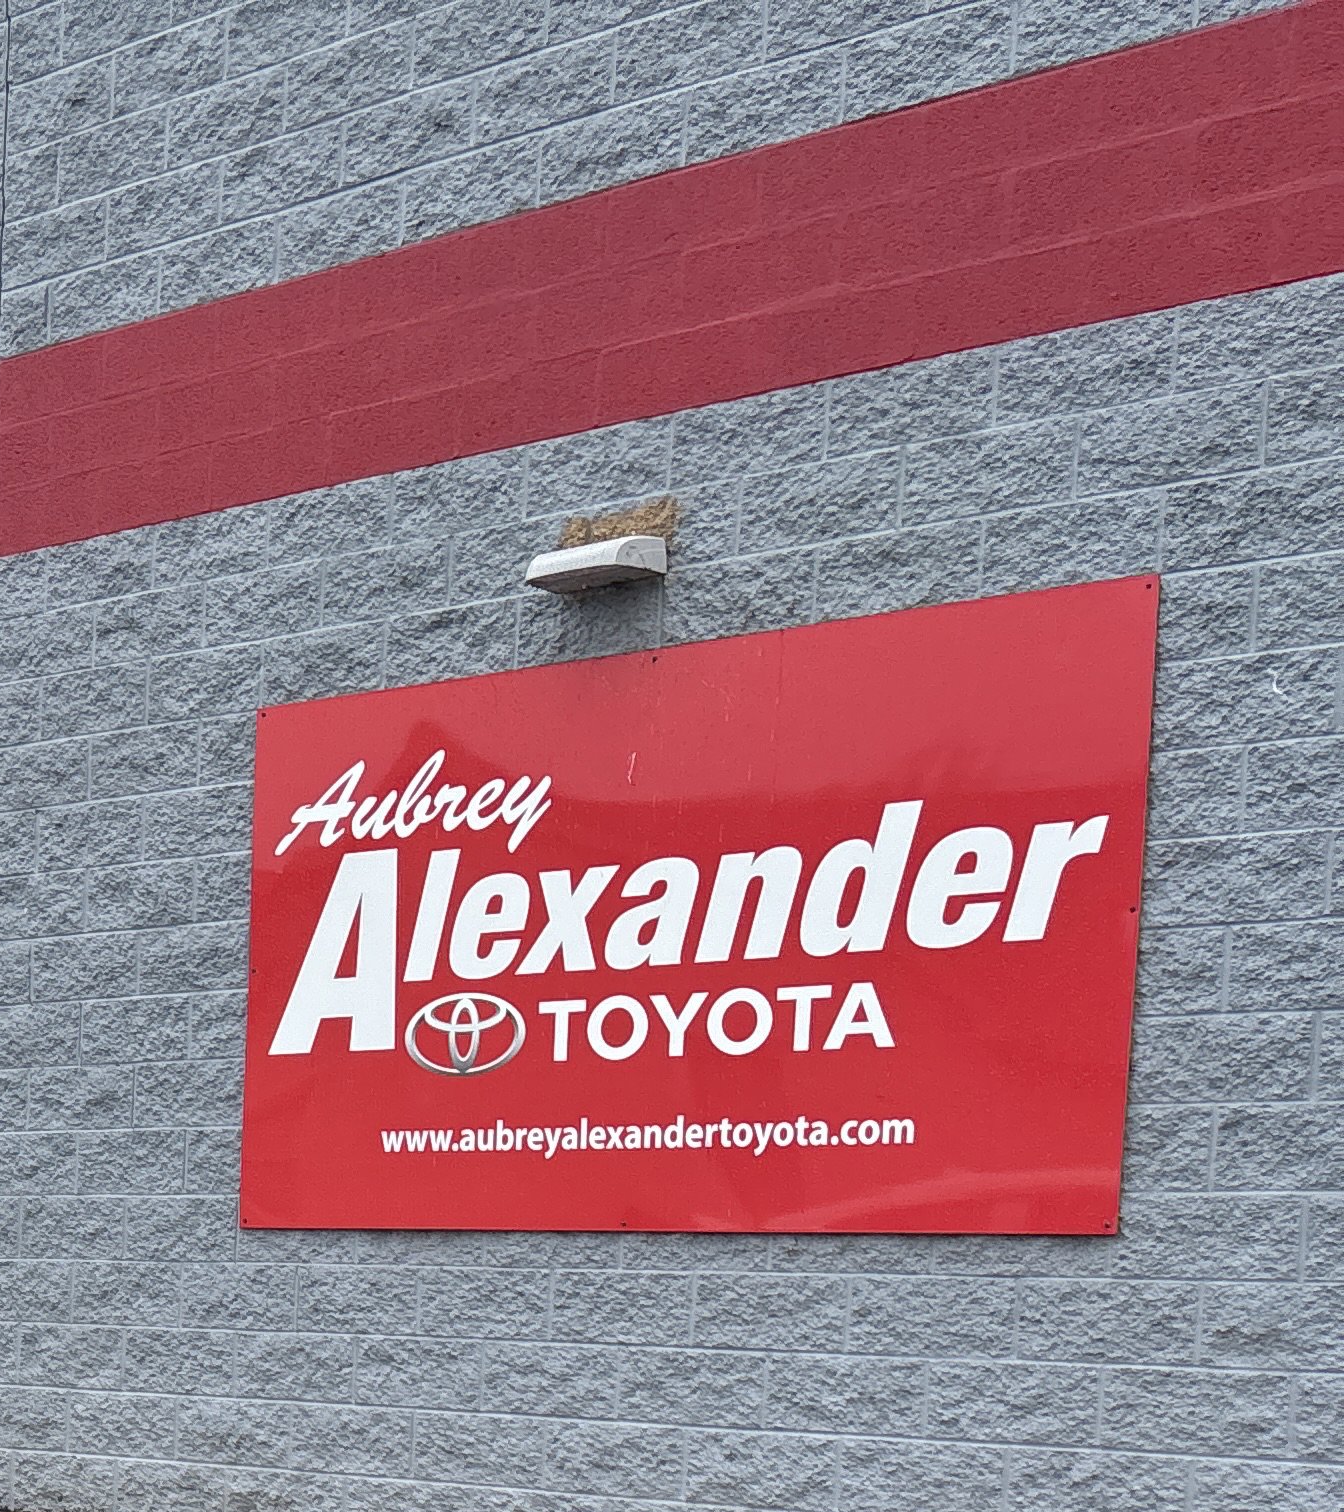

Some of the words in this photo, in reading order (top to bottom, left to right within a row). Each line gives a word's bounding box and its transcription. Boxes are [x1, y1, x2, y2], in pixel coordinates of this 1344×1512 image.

[274, 749, 552, 856] Aubrey
[267, 799, 1110, 1056] Alexander
[538, 982, 896, 1062] TOYOTA
[380, 1113, 915, 1160] www.aubreyalexandertoyota.com
